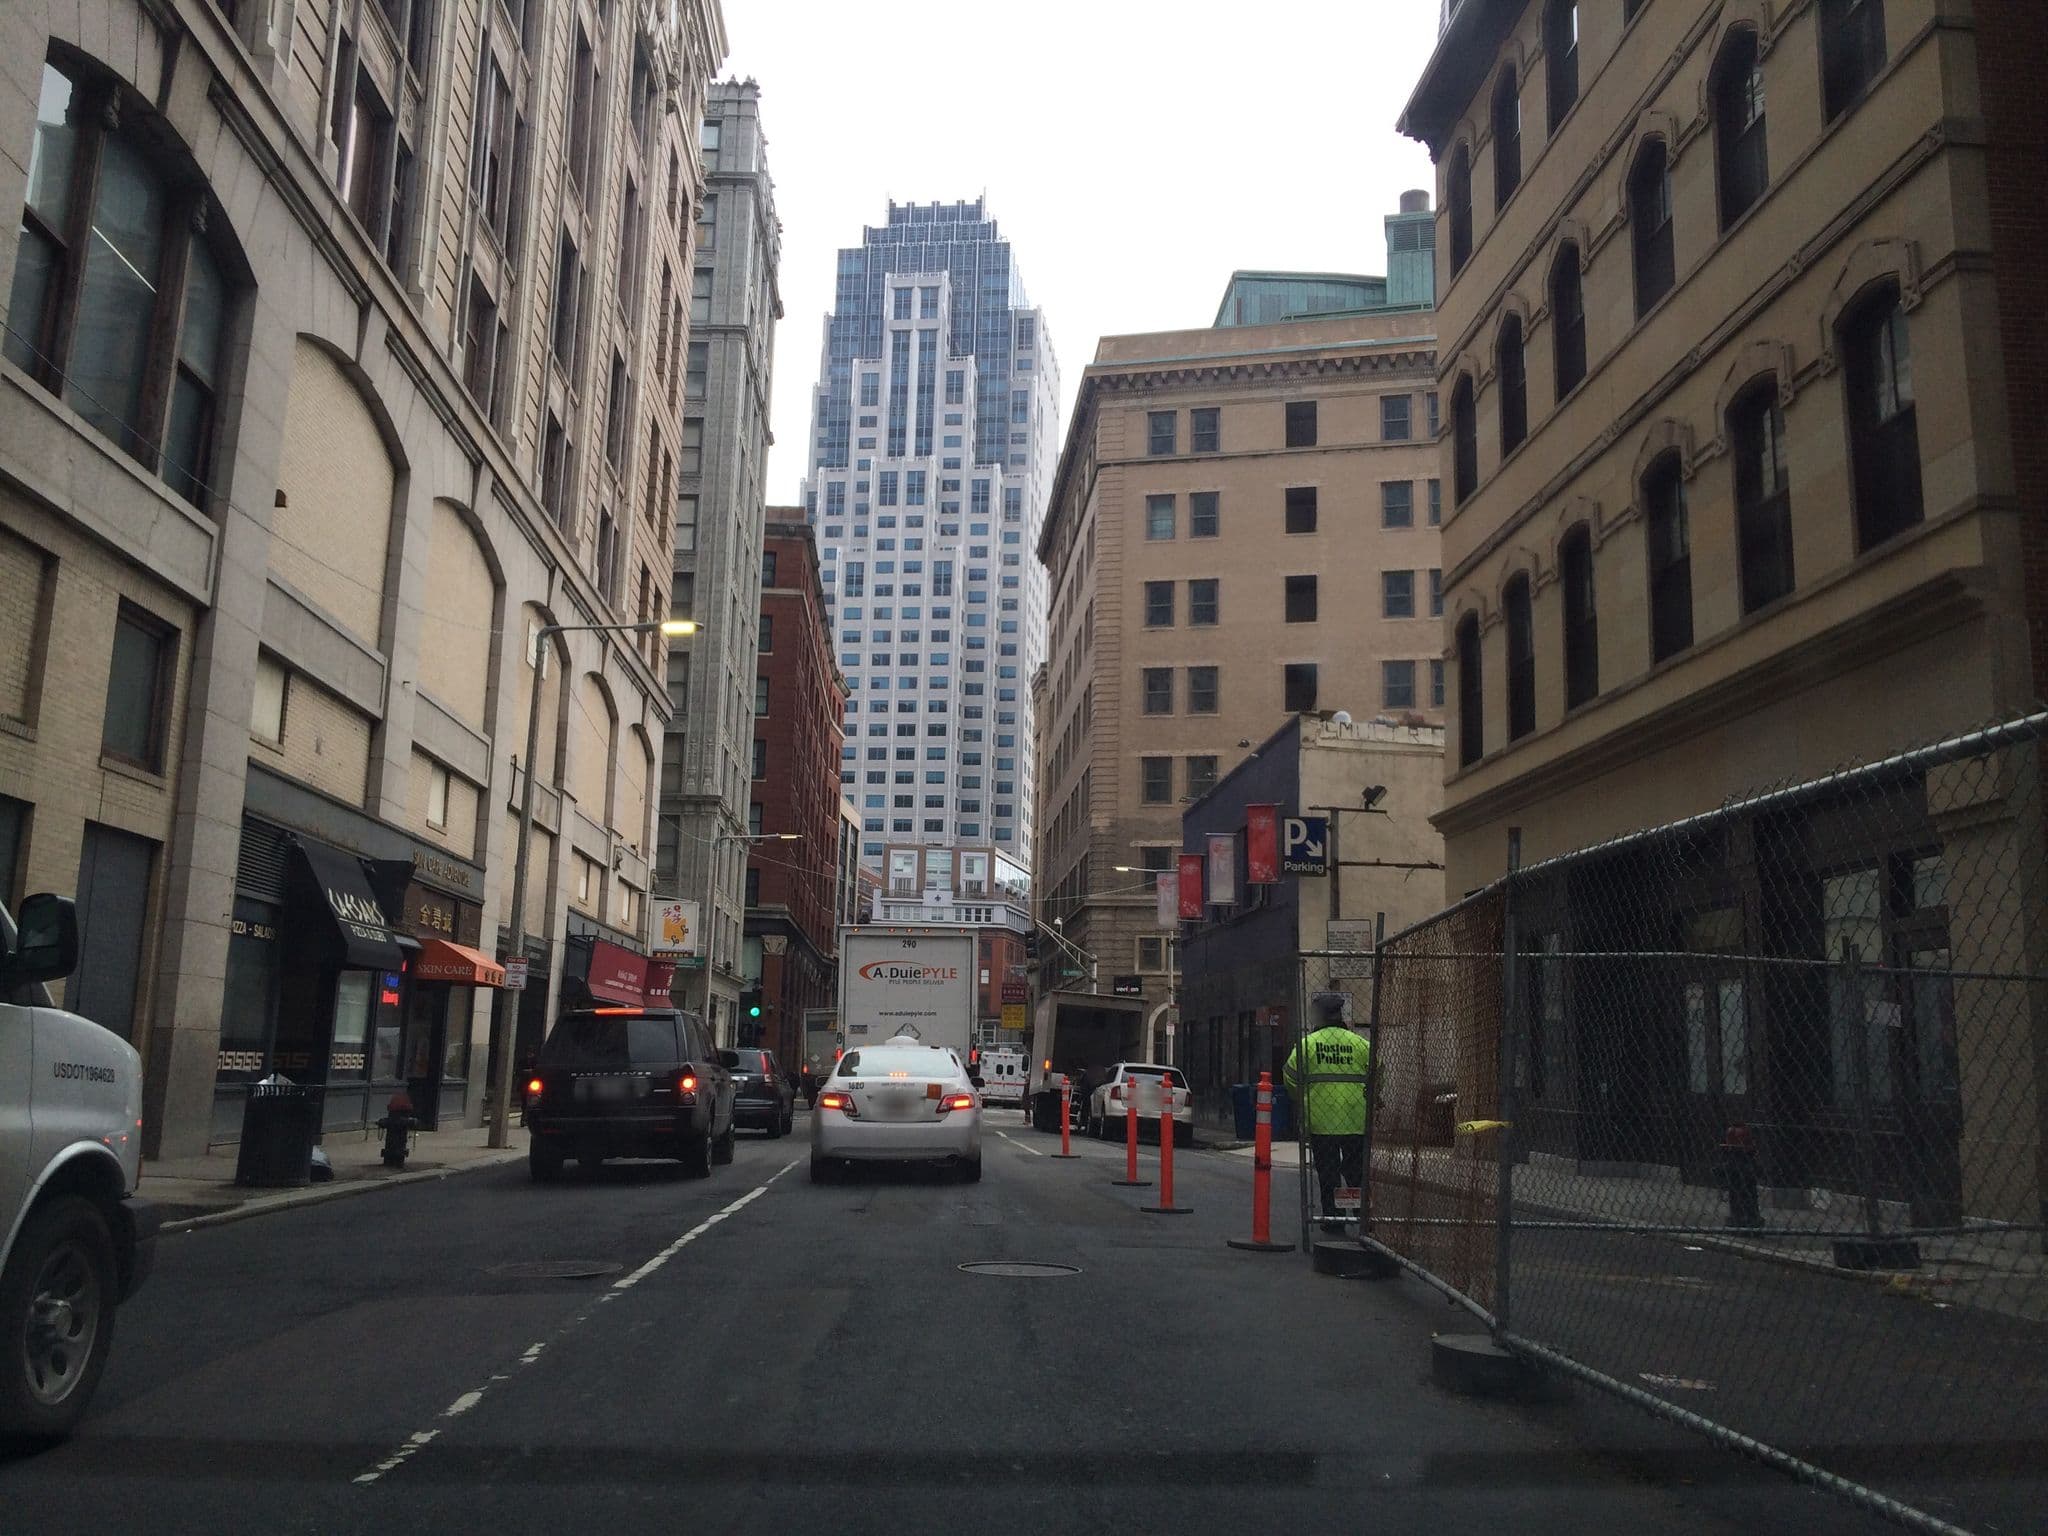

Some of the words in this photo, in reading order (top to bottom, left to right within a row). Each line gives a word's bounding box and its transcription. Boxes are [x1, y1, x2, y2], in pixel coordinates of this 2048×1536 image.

[1284, 818, 1307, 856] P
[1284, 861, 1324, 874] Parking
[902, 940, 917, 948] 290
[418, 964, 443, 974] SKIN
[444, 964, 473, 976] CARE
[1315, 1042, 1353, 1055] Boston
[1316, 1053, 1353, 1065] Police
